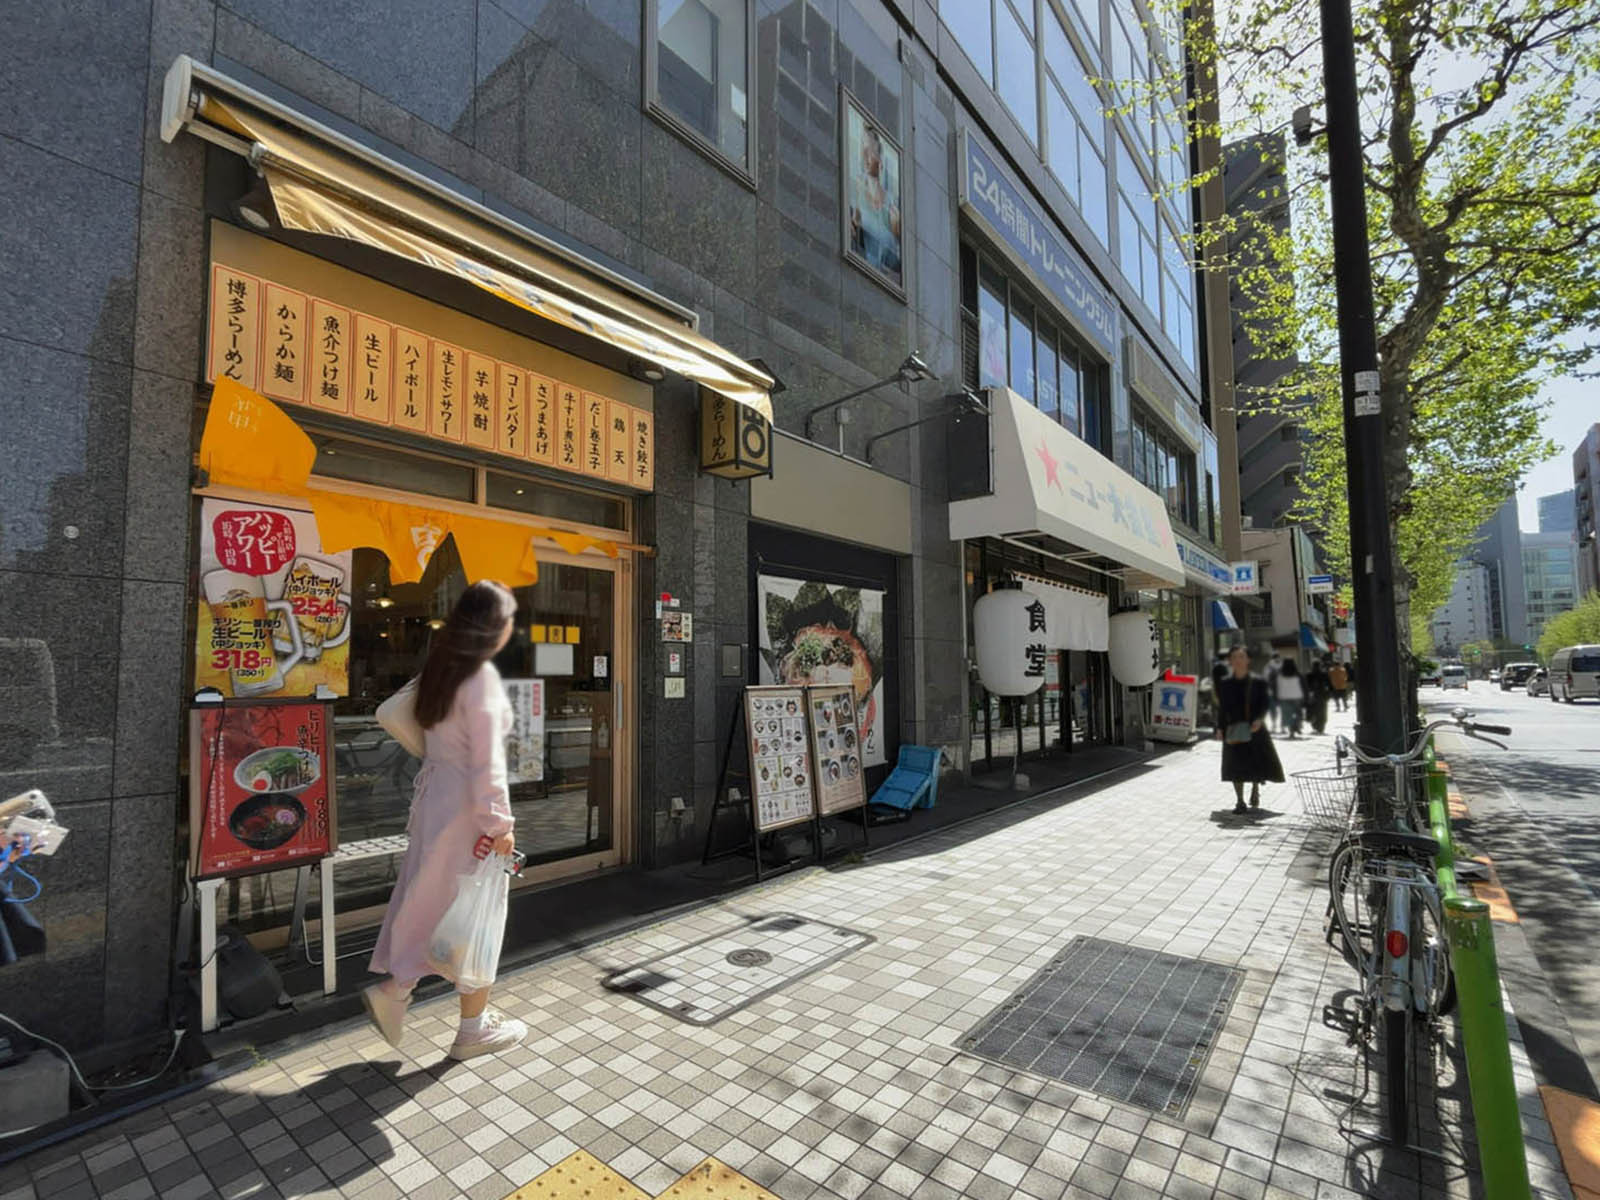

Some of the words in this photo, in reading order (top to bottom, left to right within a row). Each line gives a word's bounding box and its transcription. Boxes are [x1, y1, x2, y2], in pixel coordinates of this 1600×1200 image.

[972, 155, 1114, 342] 24時間トレーニングジム
[224, 278, 248, 381] 博多らーめん
[275, 304, 297, 383] からか麺
[321, 315, 342, 401] 魚介つけ麺
[364, 333, 382, 402] 生ビール
[404, 344, 420, 418] ハイボール
[440, 350, 455, 434] 生レモンサワー
[473, 370, 489, 431] 芋焼酎
[505, 373, 519, 449] コーンバター
[536, 383, 549, 454] さつまあげ
[564, 392, 577, 464] 牛すじ煮込み
[637, 420, 649, 477] 焼き餃子
[233, 516, 255, 568] アワー
[249, 512, 276, 570] ハッピー
[284, 573, 342, 589] ハイボール
[211, 649, 272, 670] 318円
[212, 627, 267, 640] 生ビール
[1024, 600, 1047, 677] 食堂
